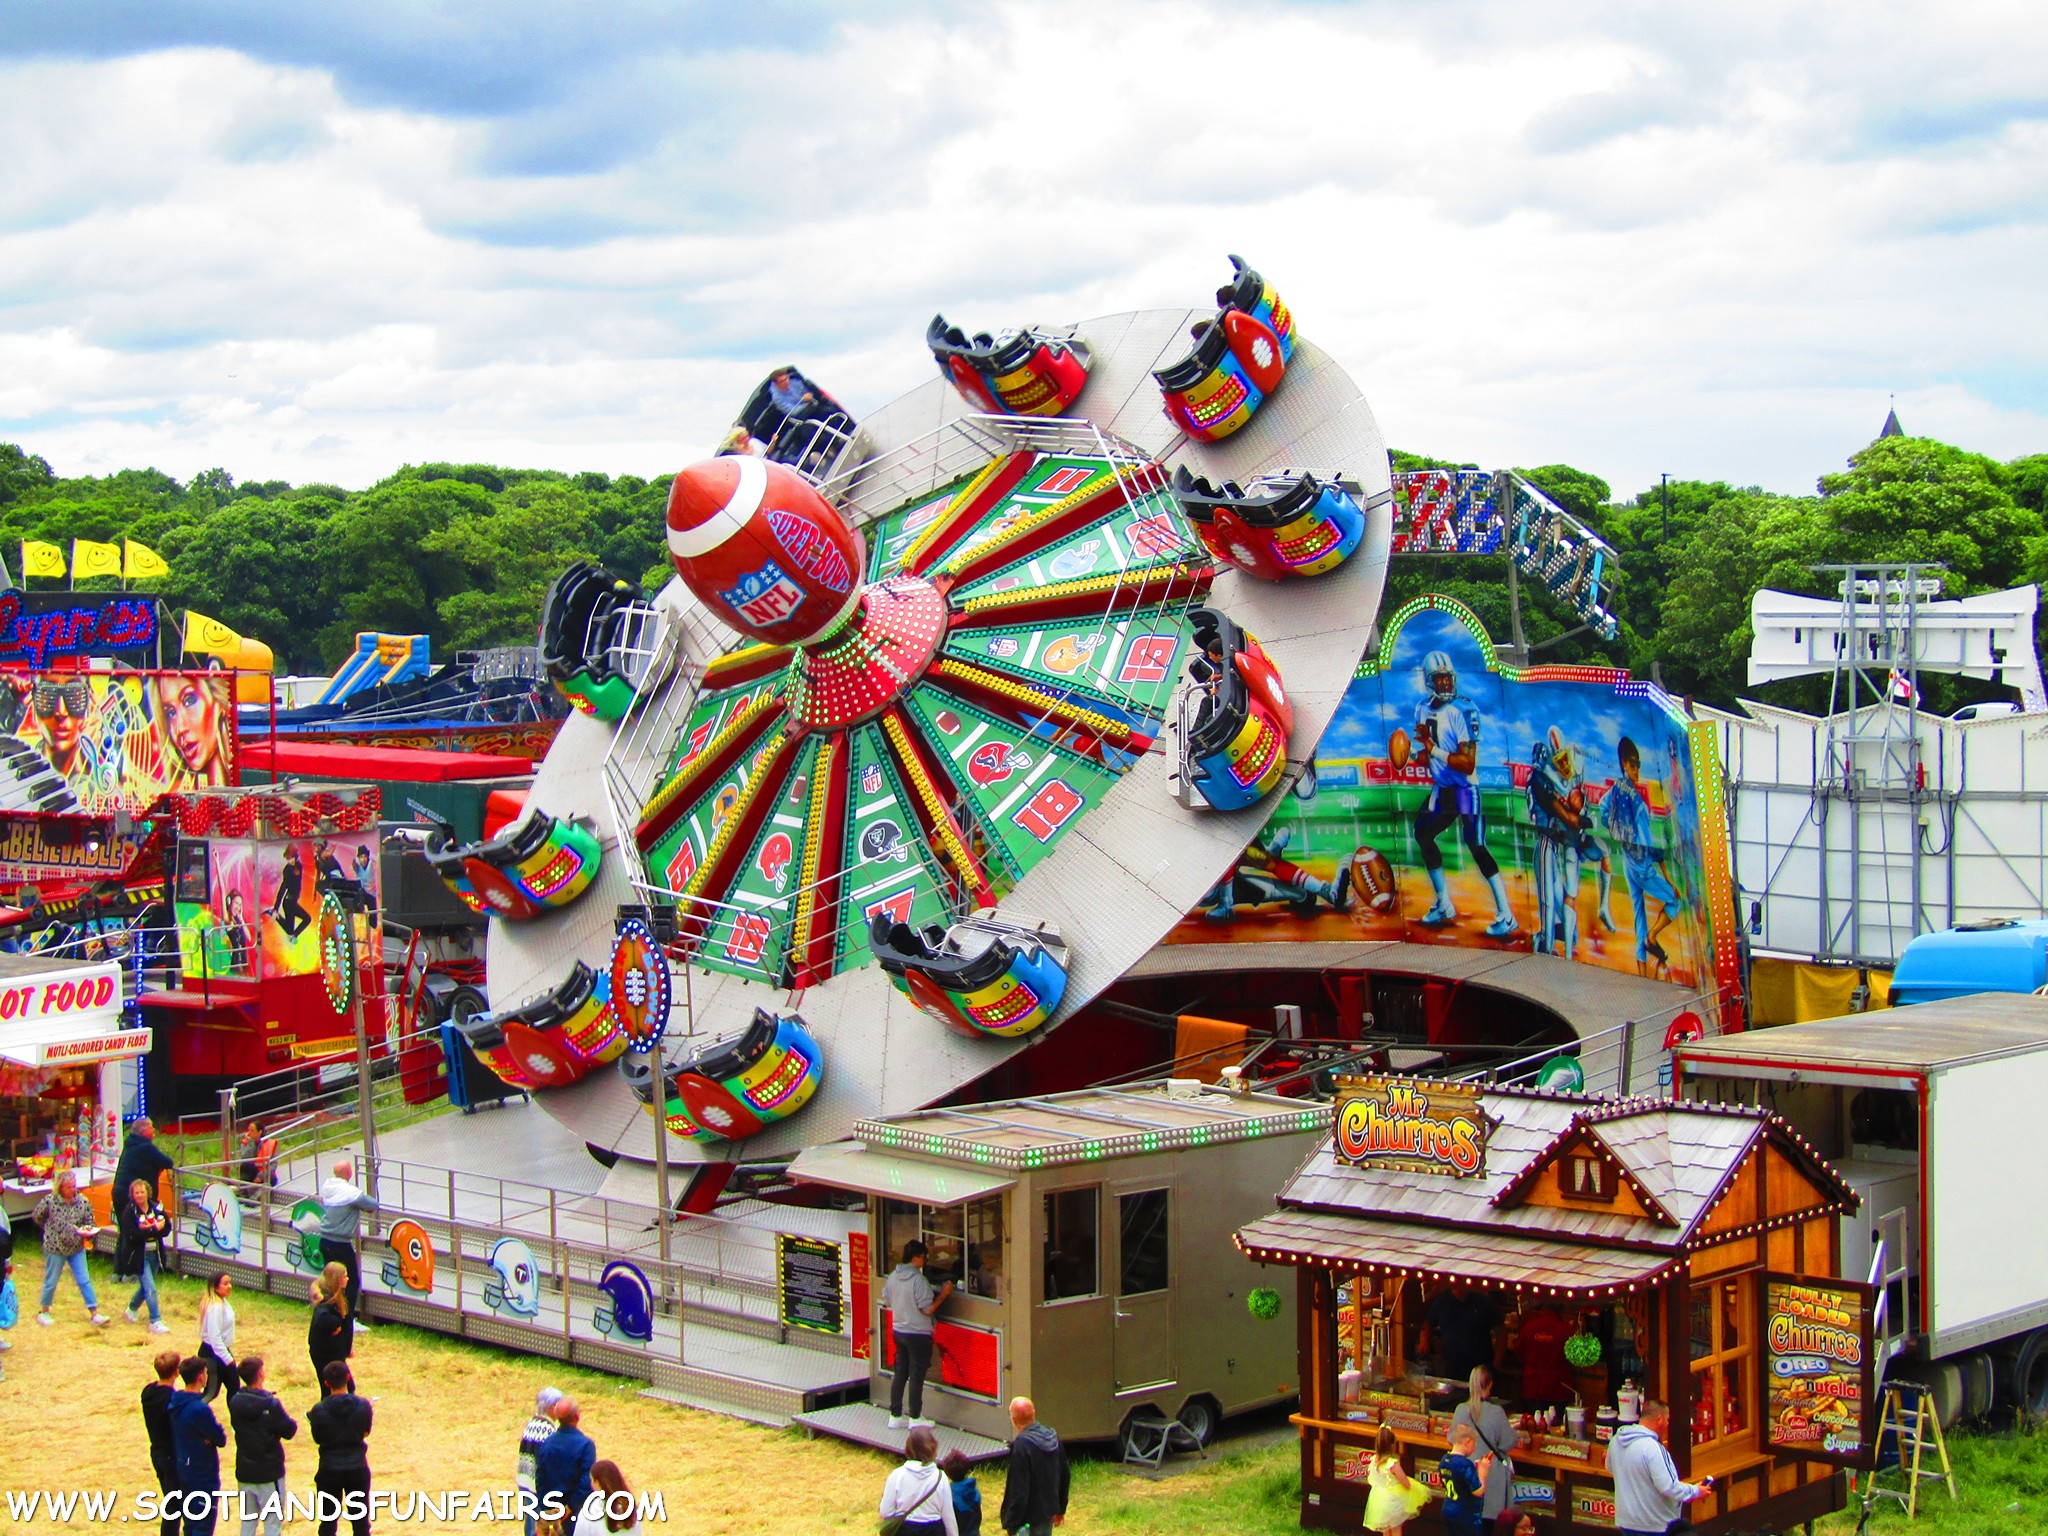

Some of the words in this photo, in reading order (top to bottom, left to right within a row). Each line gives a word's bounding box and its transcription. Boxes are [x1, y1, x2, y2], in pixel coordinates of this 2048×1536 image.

[741, 584, 800, 625] NFL
[1118, 636, 1178, 681] 19
[864, 777, 882, 794] NFL
[1012, 780, 1084, 842] 18
[0, 986, 36, 1020] OT
[41, 976, 115, 1014] FOOD
[642, 952, 659, 1024] BOWL
[104, 1036, 127, 1052] CANDY
[127, 1033, 148, 1048] FLOSS
[1388, 1086, 1426, 1118] Mr
[1339, 1100, 1479, 1171] Churros
[408, 1238, 421, 1261] G
[1790, 1285, 1842, 1309] FULLY
[1779, 1297, 1850, 1327] LOADED
[1769, 1313, 1860, 1363] Churros
[1775, 1357, 1829, 1377] OREO
[1806, 1380, 1857, 1398] nutella
[1824, 1433, 1859, 1452] Sugar
[1513, 1483, 1554, 1500] REO
[1582, 1500, 1615, 1517] nute
